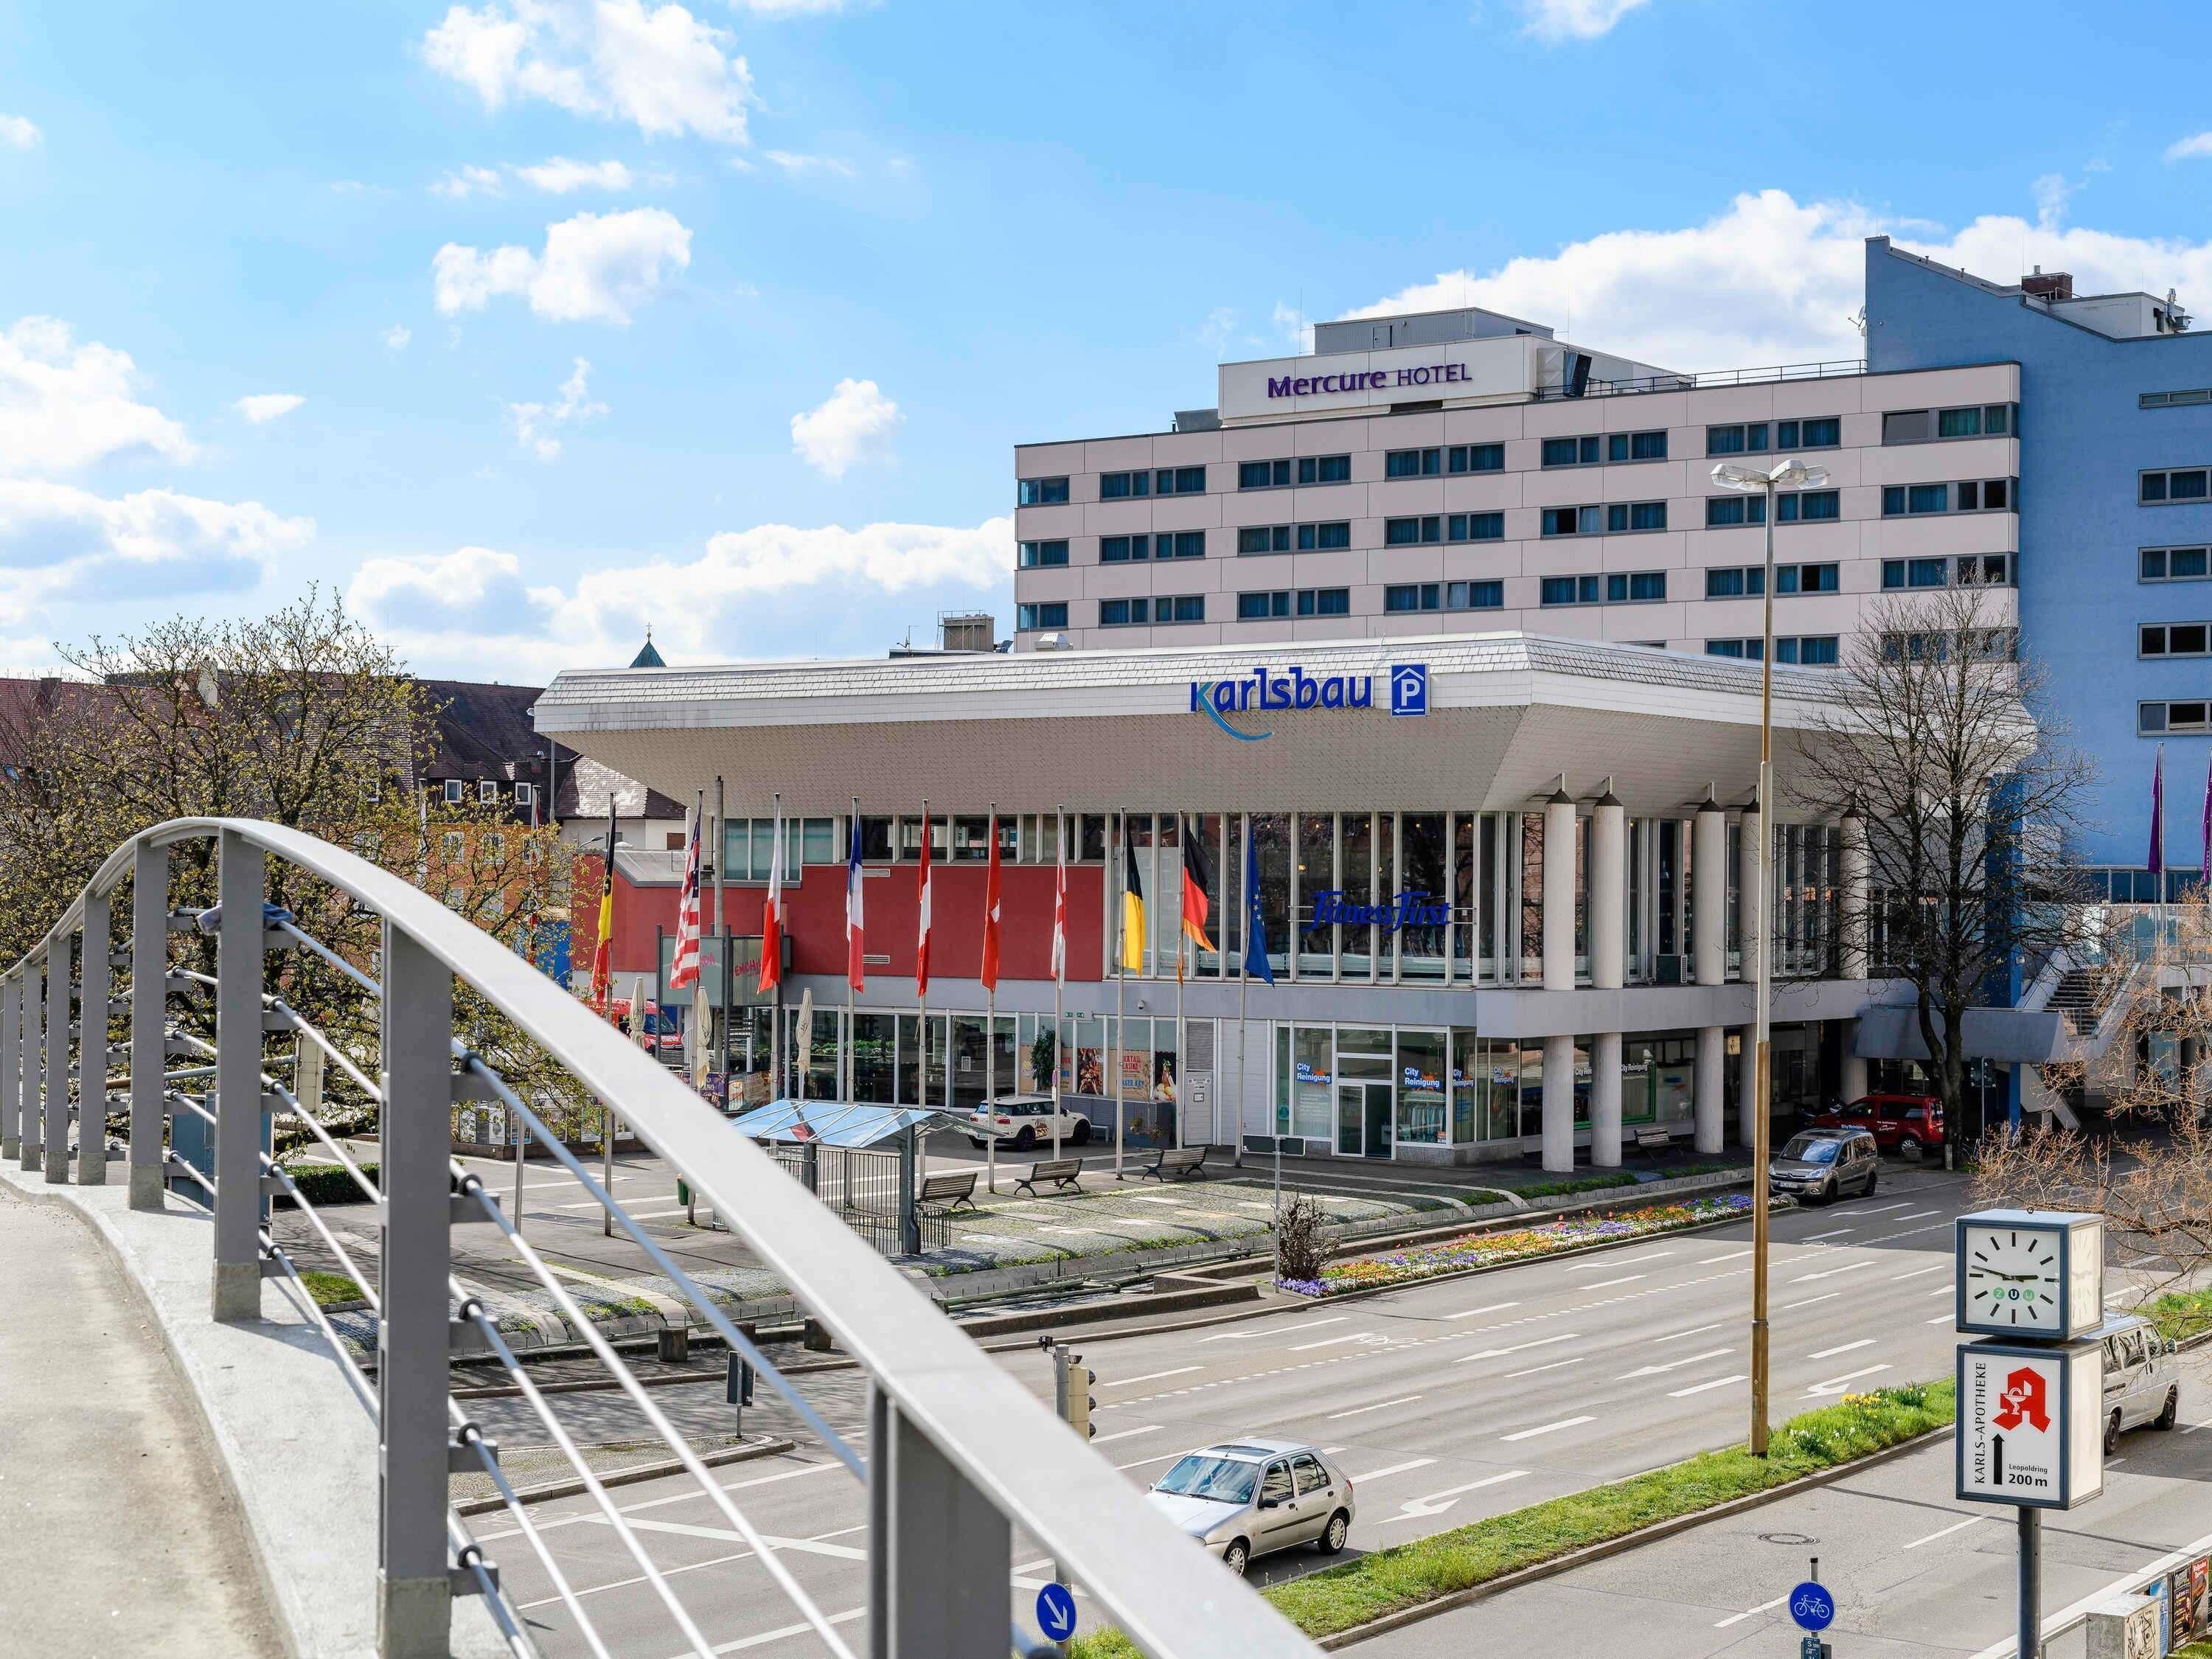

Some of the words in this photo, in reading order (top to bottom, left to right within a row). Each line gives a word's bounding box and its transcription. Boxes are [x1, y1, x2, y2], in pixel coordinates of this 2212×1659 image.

[1267, 370, 1387, 398] Mercure
[1397, 364, 1472, 386] HOTEL
[1402, 678, 1420, 706] P
[1298, 1062, 1310, 1071] City
[1493, 1066, 1503, 1074] City
[1405, 1067, 1419, 1077] City
[1453, 1068, 1462, 1077] City
[1297, 1073, 1331, 1083] Reinigung
[1405, 1077, 1439, 1088] Reinigung
[1453, 1079, 1474, 1088] Reinigung
[1975, 1363, 1986, 1484] KARLS-APOTHEKE
[2008, 1463, 2048, 1474] Leopoldring
[2008, 1473, 2032, 1485] 200
[2035, 1478, 2048, 1487] m
